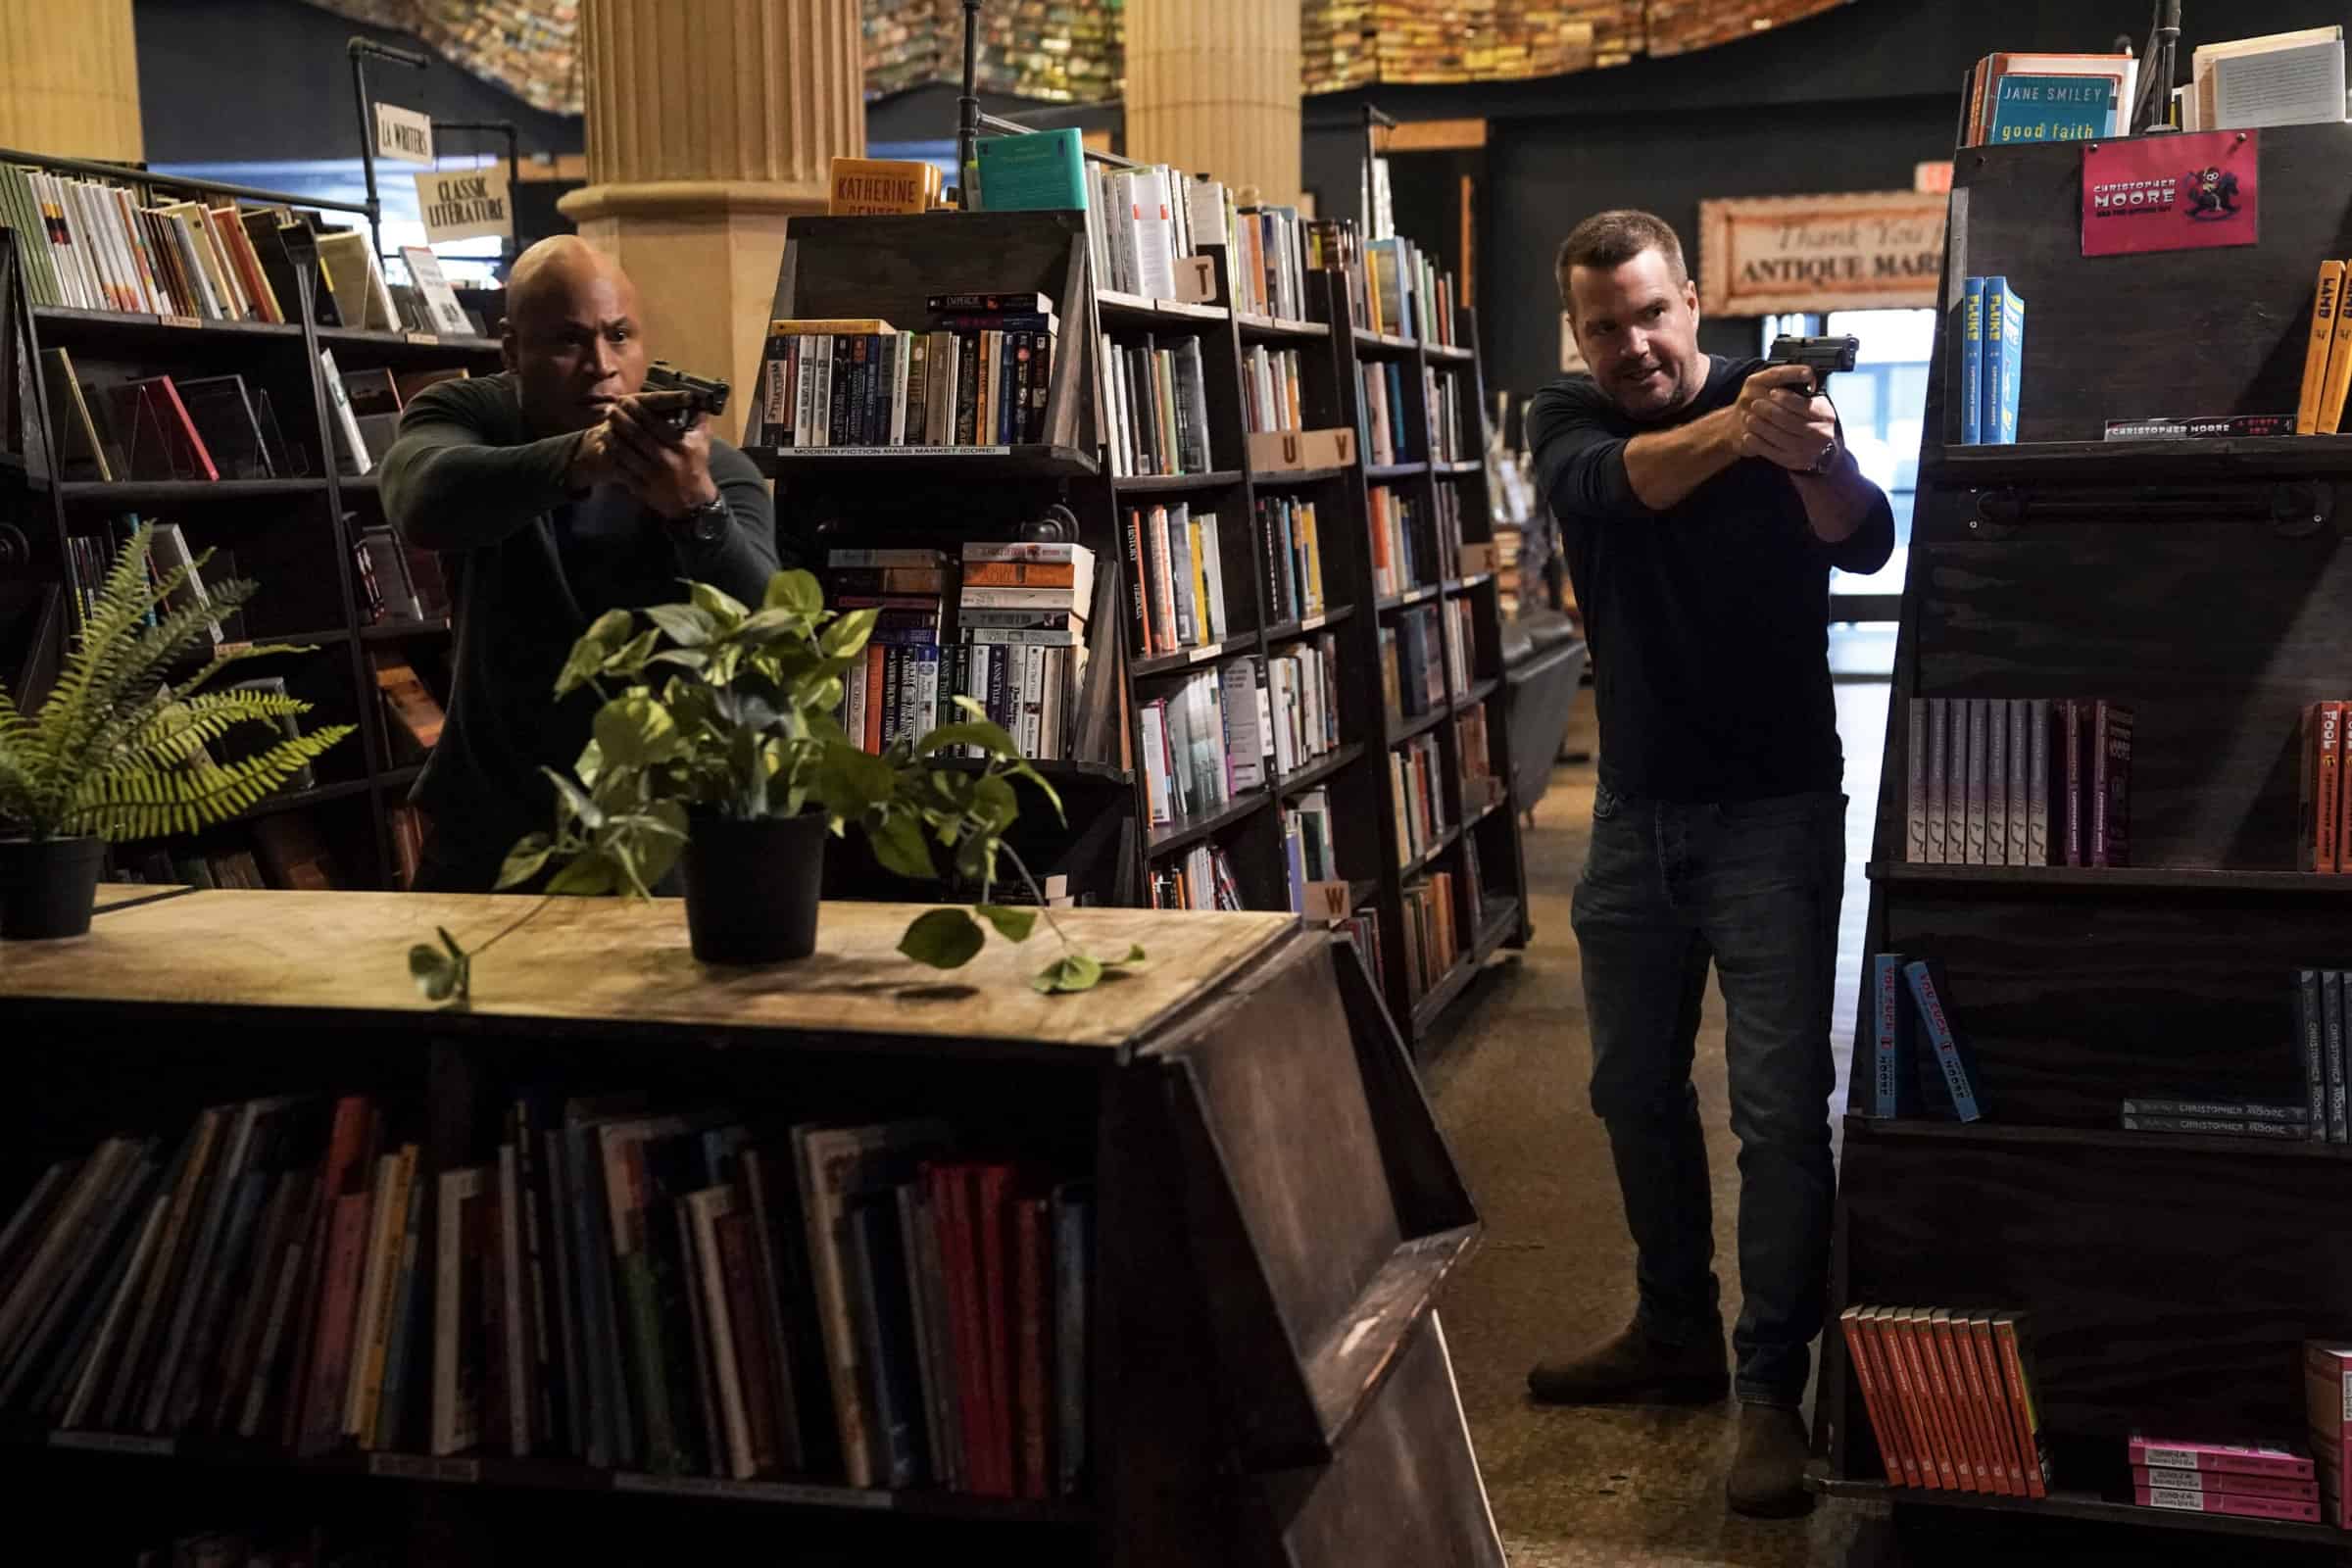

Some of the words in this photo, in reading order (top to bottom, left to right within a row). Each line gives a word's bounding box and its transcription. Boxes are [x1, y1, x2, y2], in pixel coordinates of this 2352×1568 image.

[2003, 86, 2039, 101] JANE
[2046, 86, 2103, 101] SMILEY
[393, 123, 428, 156] WRITERS
[2002, 122, 2044, 141] good
[2053, 122, 2094, 140] faith
[437, 177, 489, 201] CLASSIC
[838, 175, 916, 204] KATHERINE
[2092, 177, 2177, 192] CHRISTOPHER
[2093, 187, 2177, 209] MOORE
[428, 198, 504, 227] LITERATURE
[1779, 221, 1858, 250] Thank
[1877, 217, 1923, 245] You
[1194, 263, 1210, 296] T
[1967, 294, 1980, 341] FLUKE
[1989, 294, 2001, 341] FLUKE
[2111, 425, 2188, 436] CHRISTOPHER
[2190, 423, 2230, 433] MOORE
[1282, 435, 1298, 464] U
[1336, 434, 1348, 461] V
[2323, 710, 2337, 750] Fool
[1324, 884, 1345, 908] W
